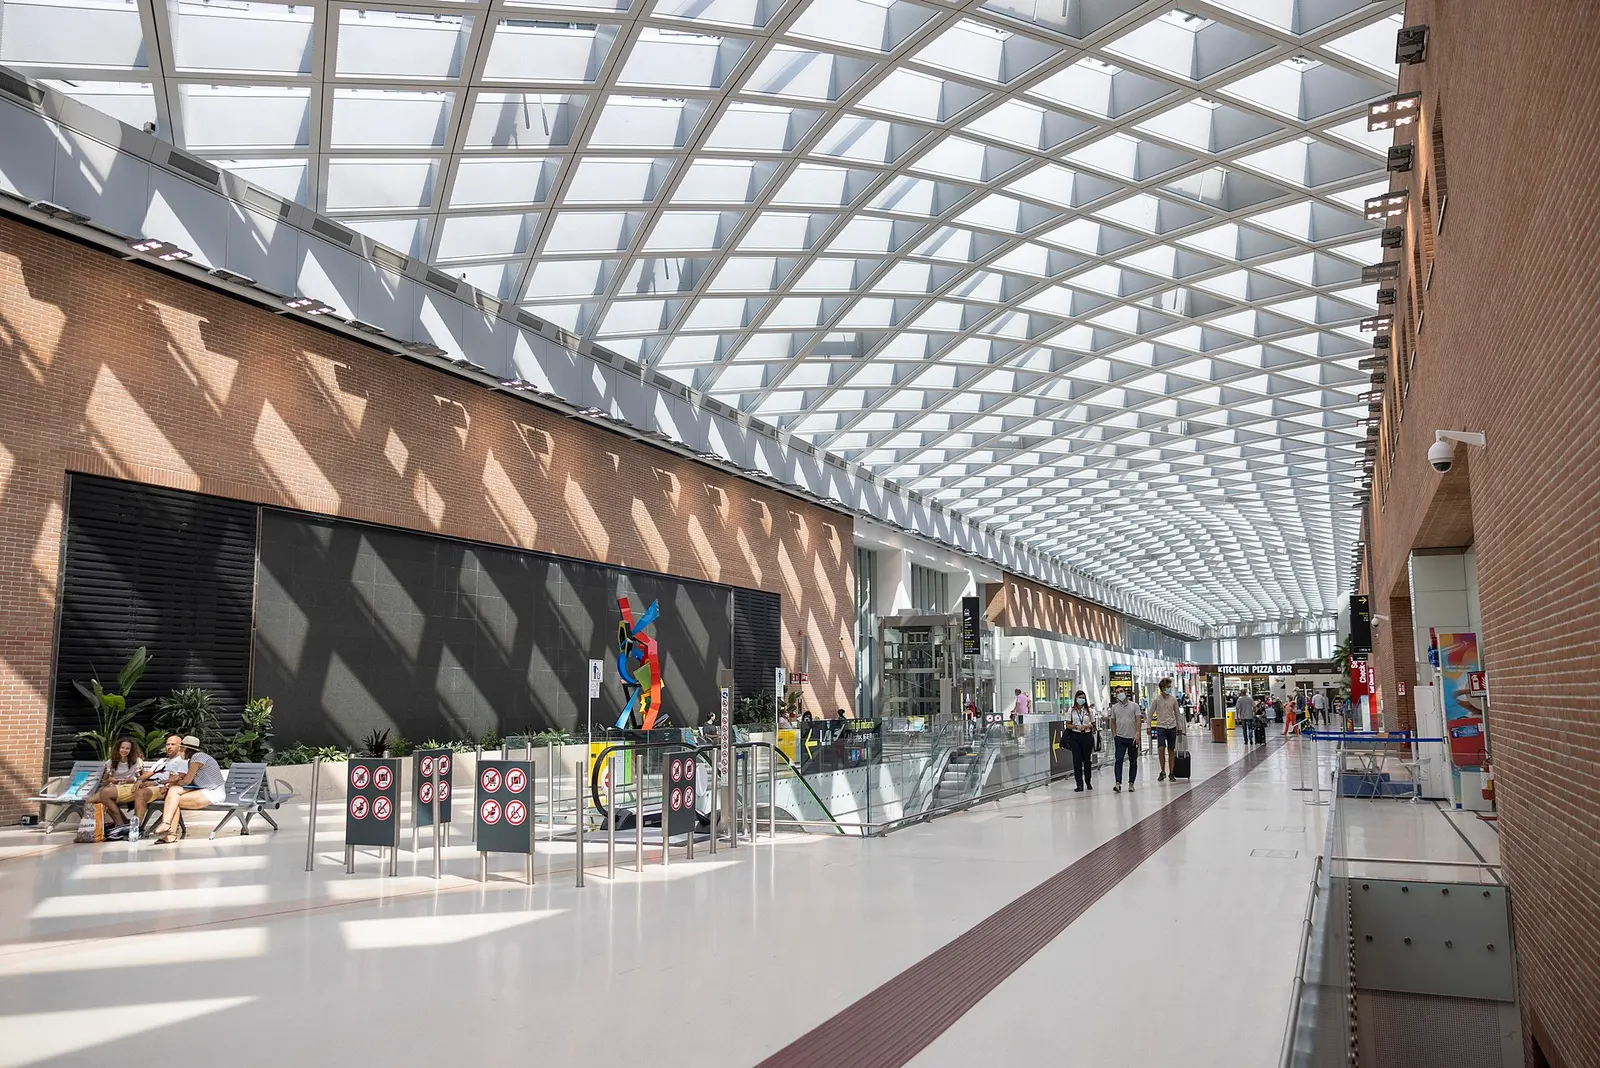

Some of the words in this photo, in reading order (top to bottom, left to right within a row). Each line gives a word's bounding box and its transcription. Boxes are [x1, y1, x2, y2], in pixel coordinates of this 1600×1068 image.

[1217, 665, 1249, 674] KITCHEN
[1252, 665, 1273, 674] PIZZA
[1276, 665, 1292, 673] BAR
